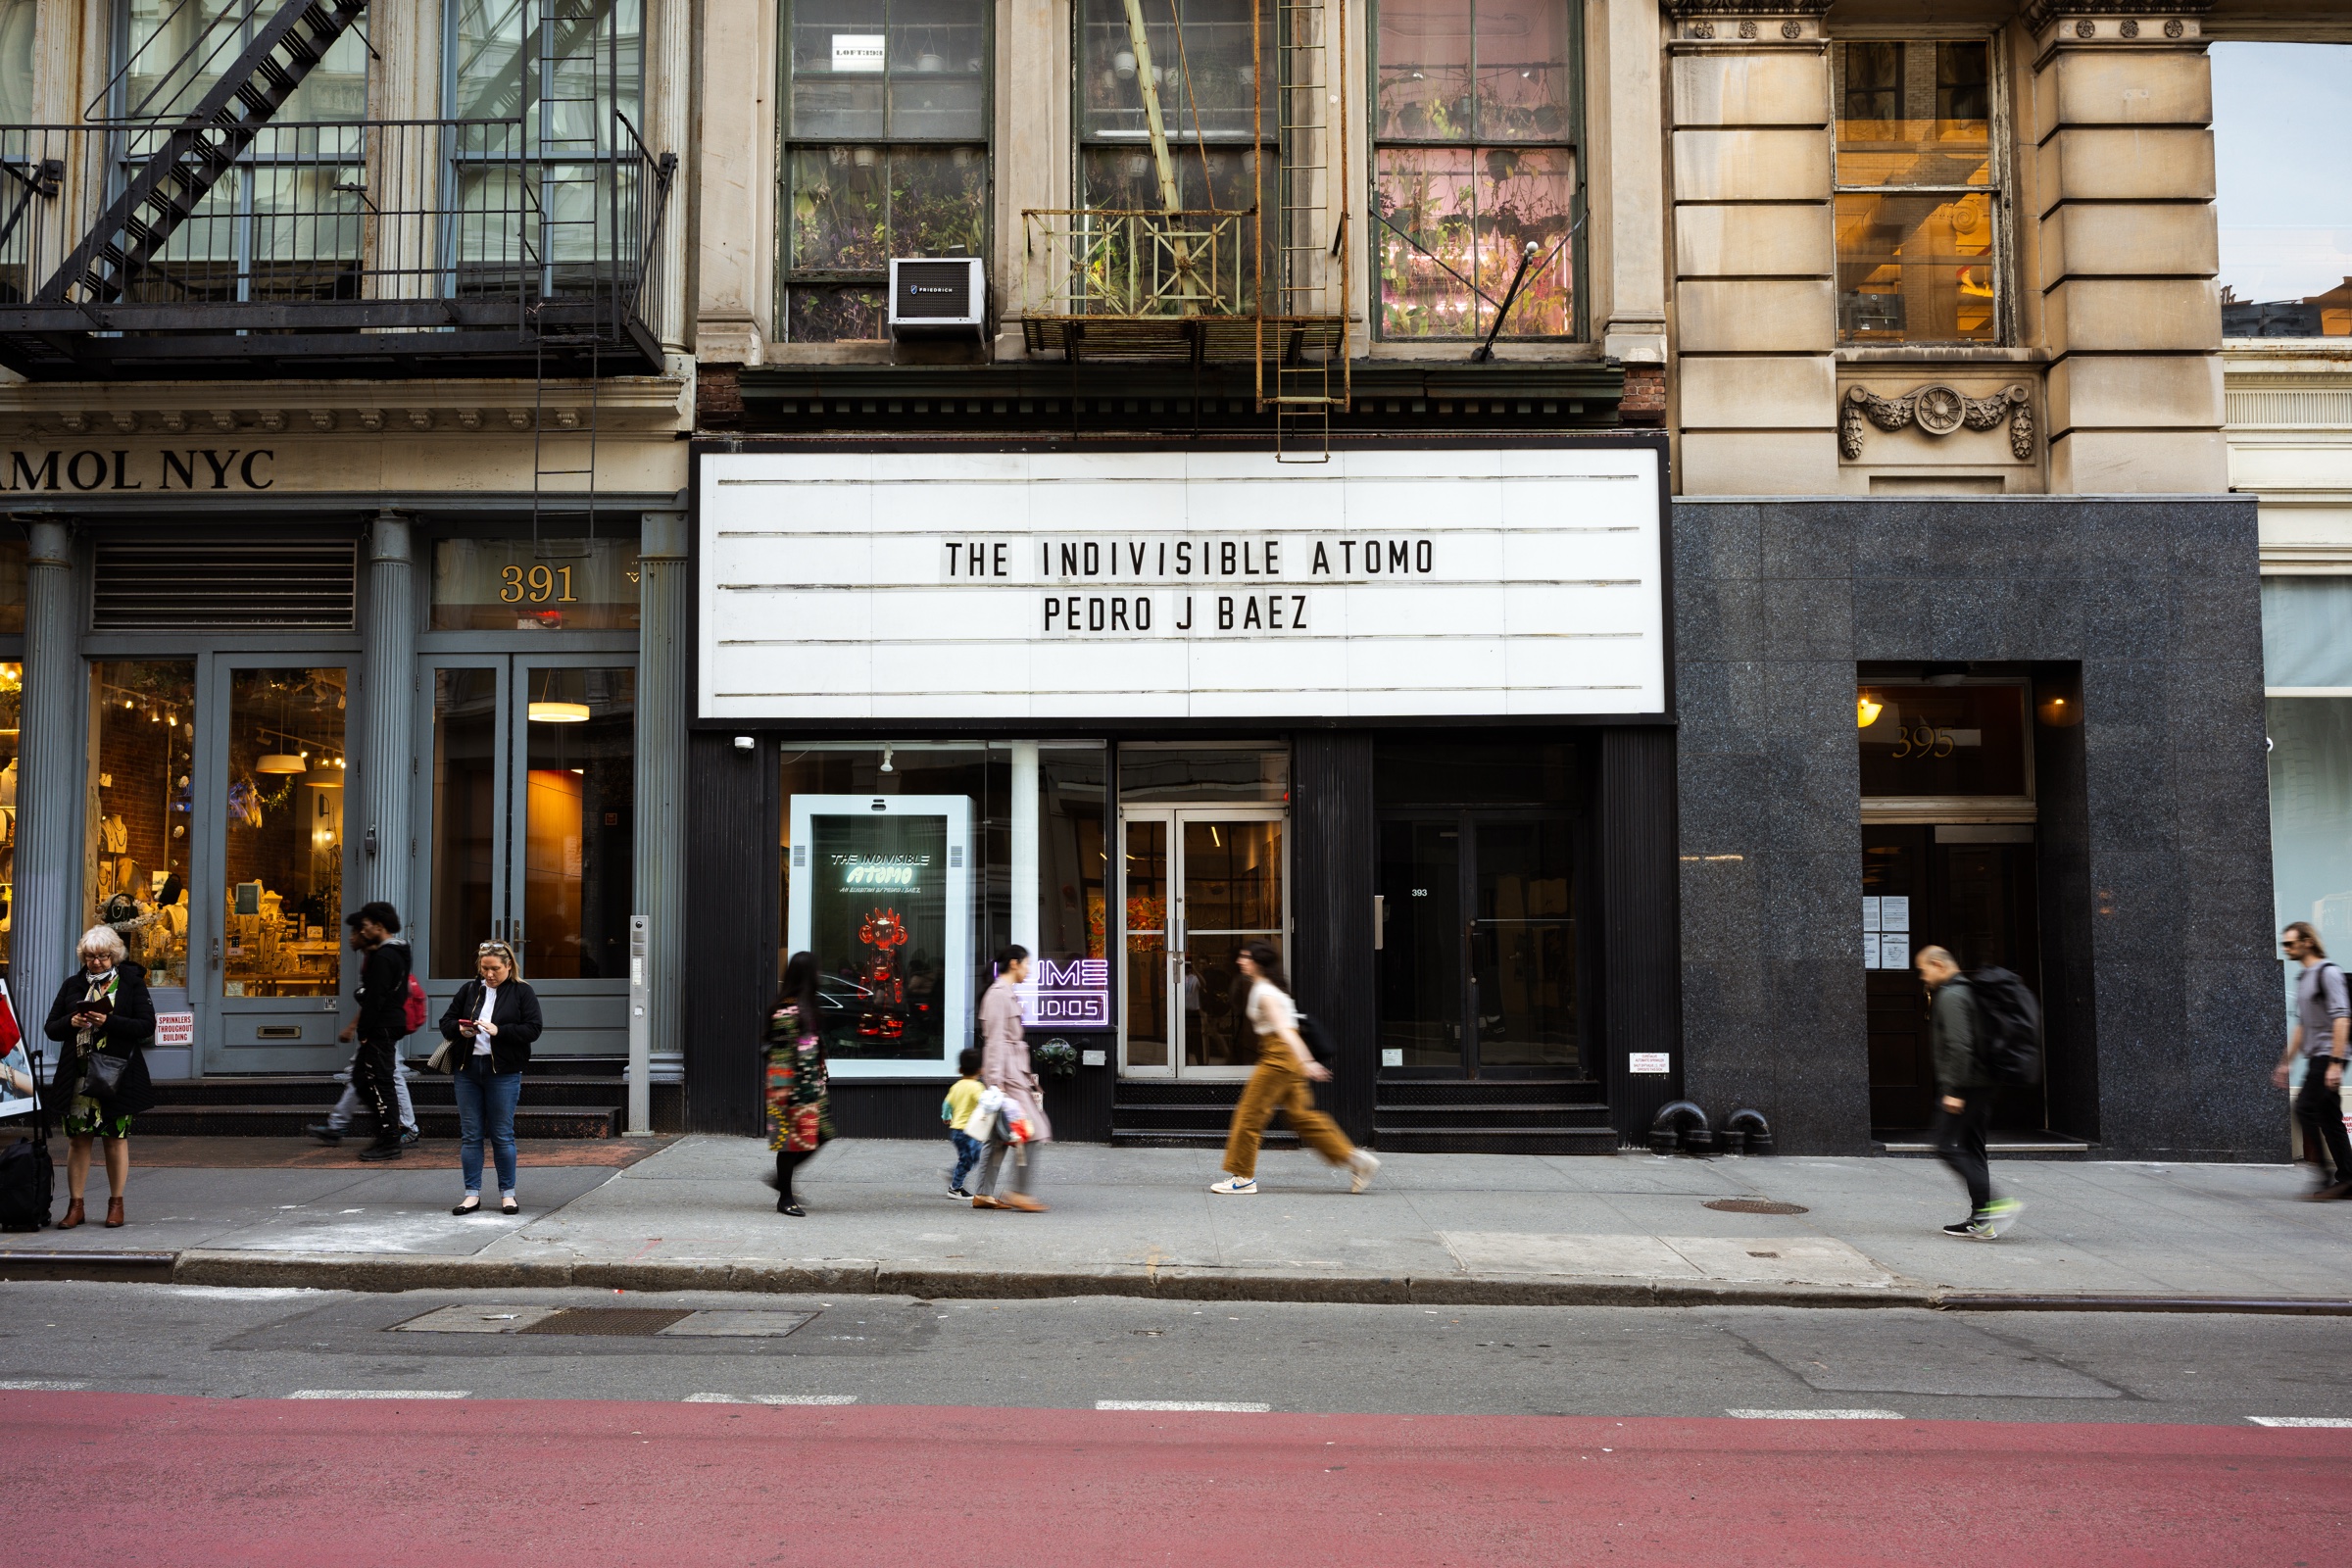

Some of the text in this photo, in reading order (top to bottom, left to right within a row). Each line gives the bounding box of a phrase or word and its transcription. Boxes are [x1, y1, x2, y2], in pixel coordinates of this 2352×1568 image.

[0, 449, 274, 490] MOL NYC
[945, 539, 1432, 576] THE INDIVISIBLE ATOMO
[500, 564, 578, 603] 391
[1045, 595, 1307, 631] PEDRO J BAEZ
[1891, 725, 1954, 759] 395
[831, 854, 930, 865] THE INDIVISIBLE
[846, 865, 912, 885] ATOMO
[1412, 888, 1428, 897] 393
[994, 960, 1108, 986] UME
[1017, 1001, 1099, 1016] TUDIOS
